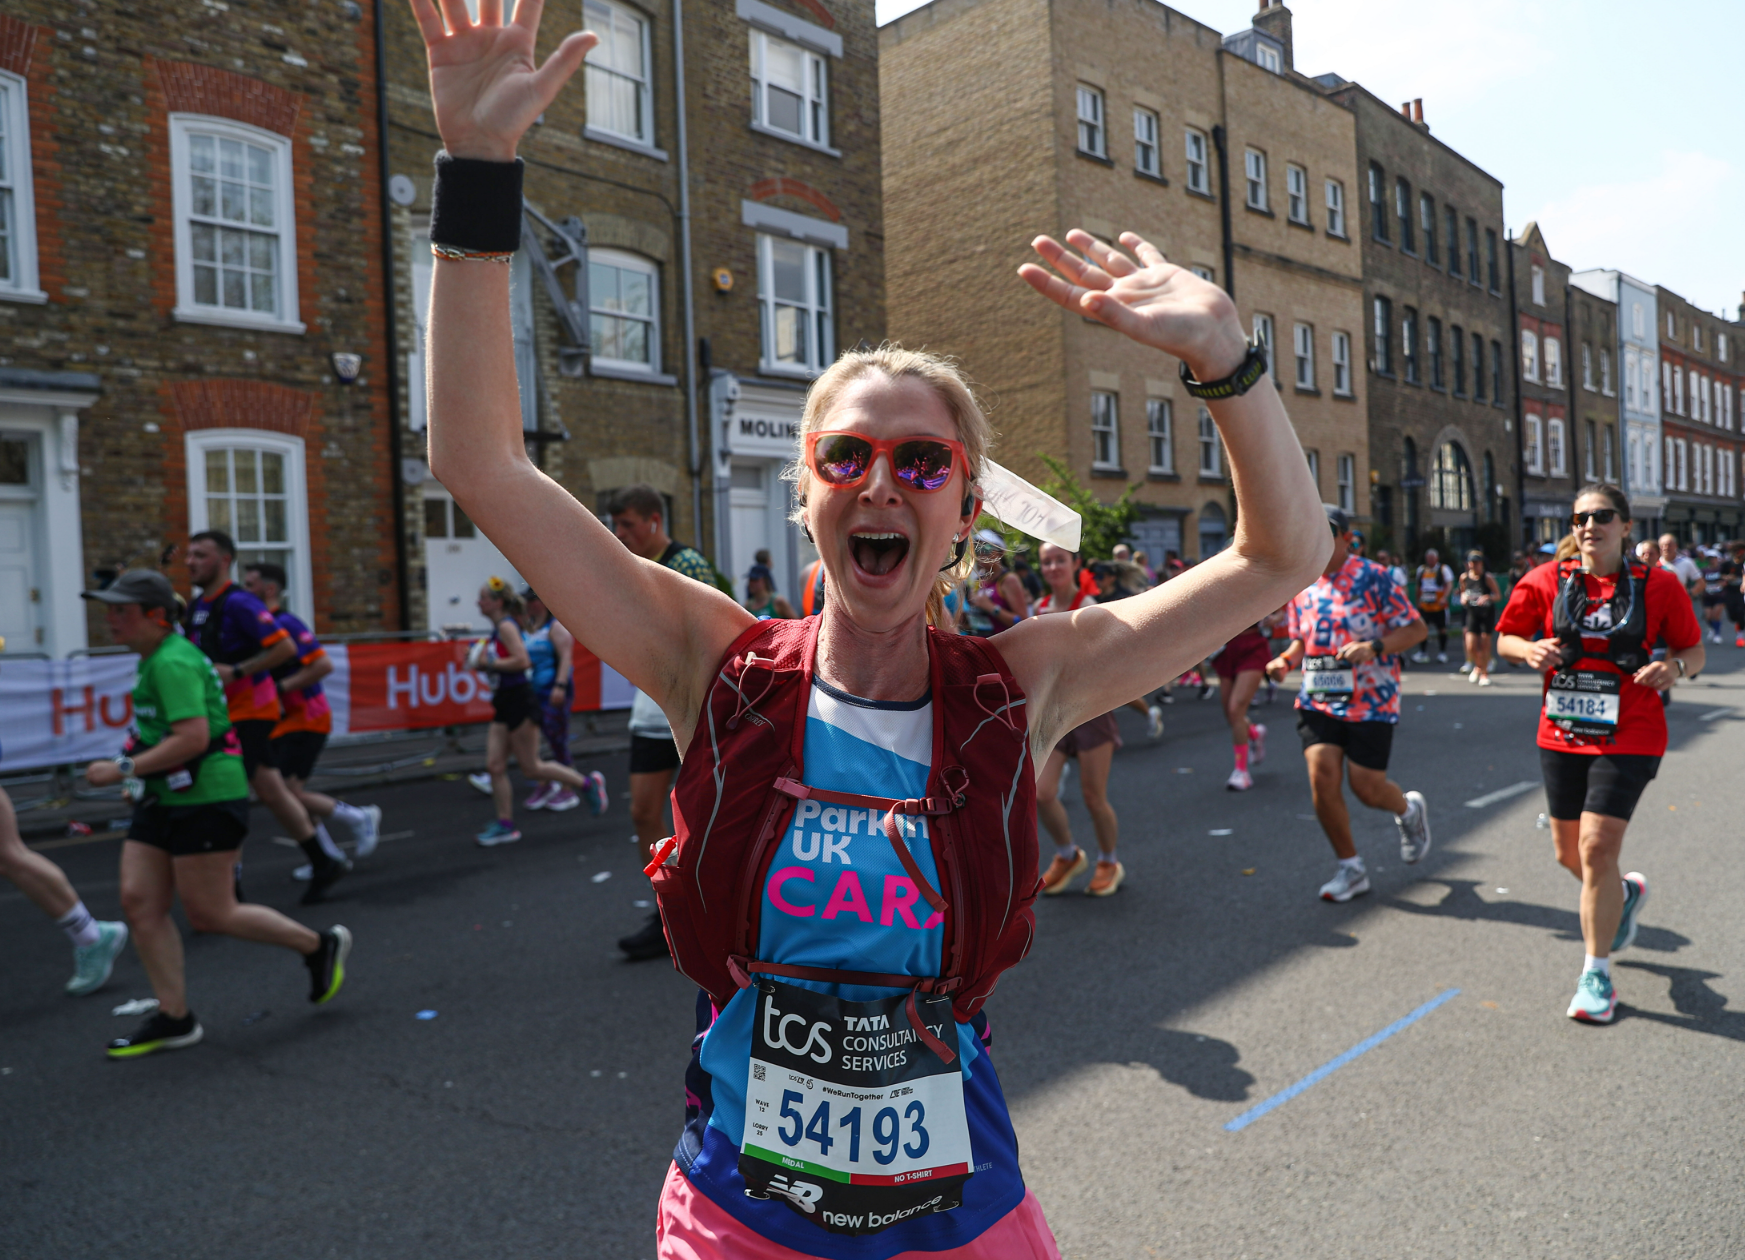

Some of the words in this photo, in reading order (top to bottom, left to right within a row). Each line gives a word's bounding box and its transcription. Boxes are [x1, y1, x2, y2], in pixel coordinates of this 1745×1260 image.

[1557, 696, 1605, 716] 54184
[792, 829, 851, 865] UK
[763, 995, 832, 1064] tcs
[844, 1014, 890, 1032] TATA
[841, 1050, 907, 1072] SERVICES
[755, 1098, 770, 1108] WAVE
[822, 1086, 884, 1101] #WeRunTogether
[777, 1088, 930, 1166] 54193
[782, 1156, 805, 1169] MEDAL
[894, 1175, 905, 1184] NO
[906, 1169, 933, 1181] T-SHIRT
[822, 1210, 865, 1228] new
[868, 1195, 943, 1228] balance
